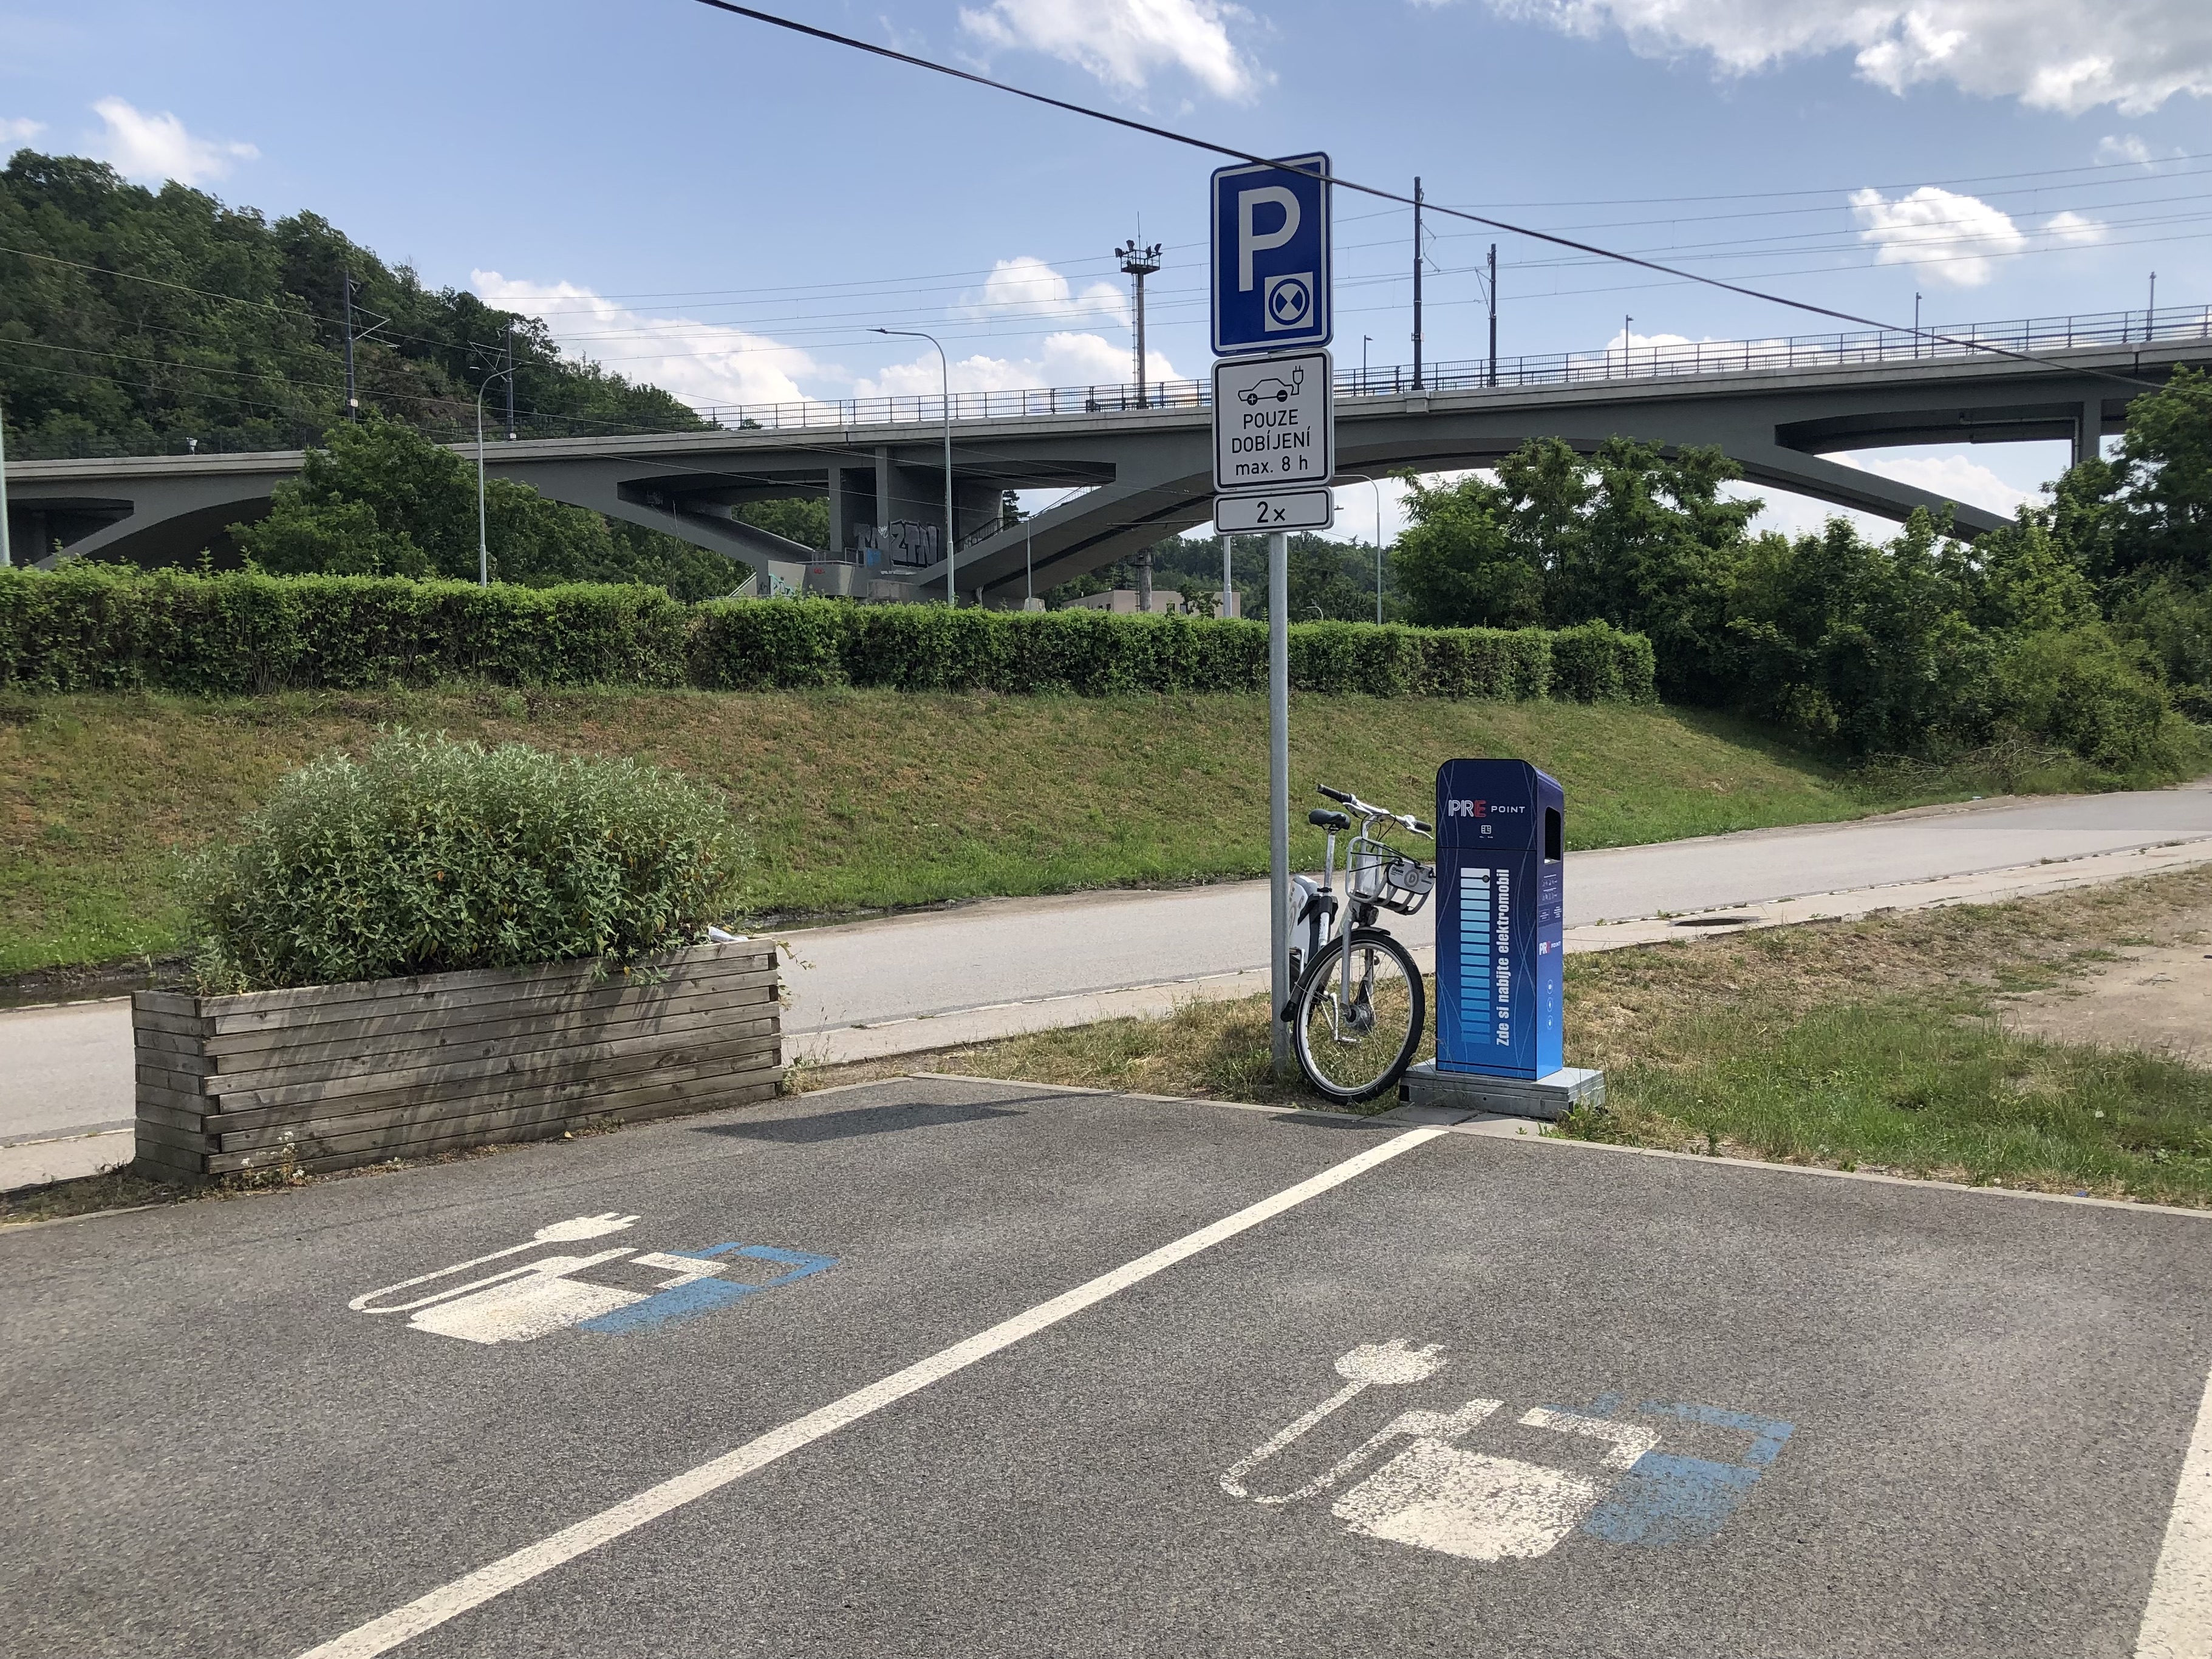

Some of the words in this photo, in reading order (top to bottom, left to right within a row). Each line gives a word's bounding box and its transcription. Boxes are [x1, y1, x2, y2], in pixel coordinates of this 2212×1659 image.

[1238, 186, 1301, 292] P
[1243, 409, 1299, 430] POUZE
[1232, 425, 1311, 454] DOBÍJENÍ
[1235, 462, 1274, 476] max.
[1282, 455, 1291, 472] 8
[1299, 454, 1308, 471] h
[1448, 799, 1487, 818] PRE
[1491, 805, 1526, 814] POINT
[1496, 869, 1509, 953] elektromobil
[1496, 957, 1511, 1003] nabijte
[1496, 1006, 1509, 1019] si
[1496, 1023, 1509, 1046] Zde
